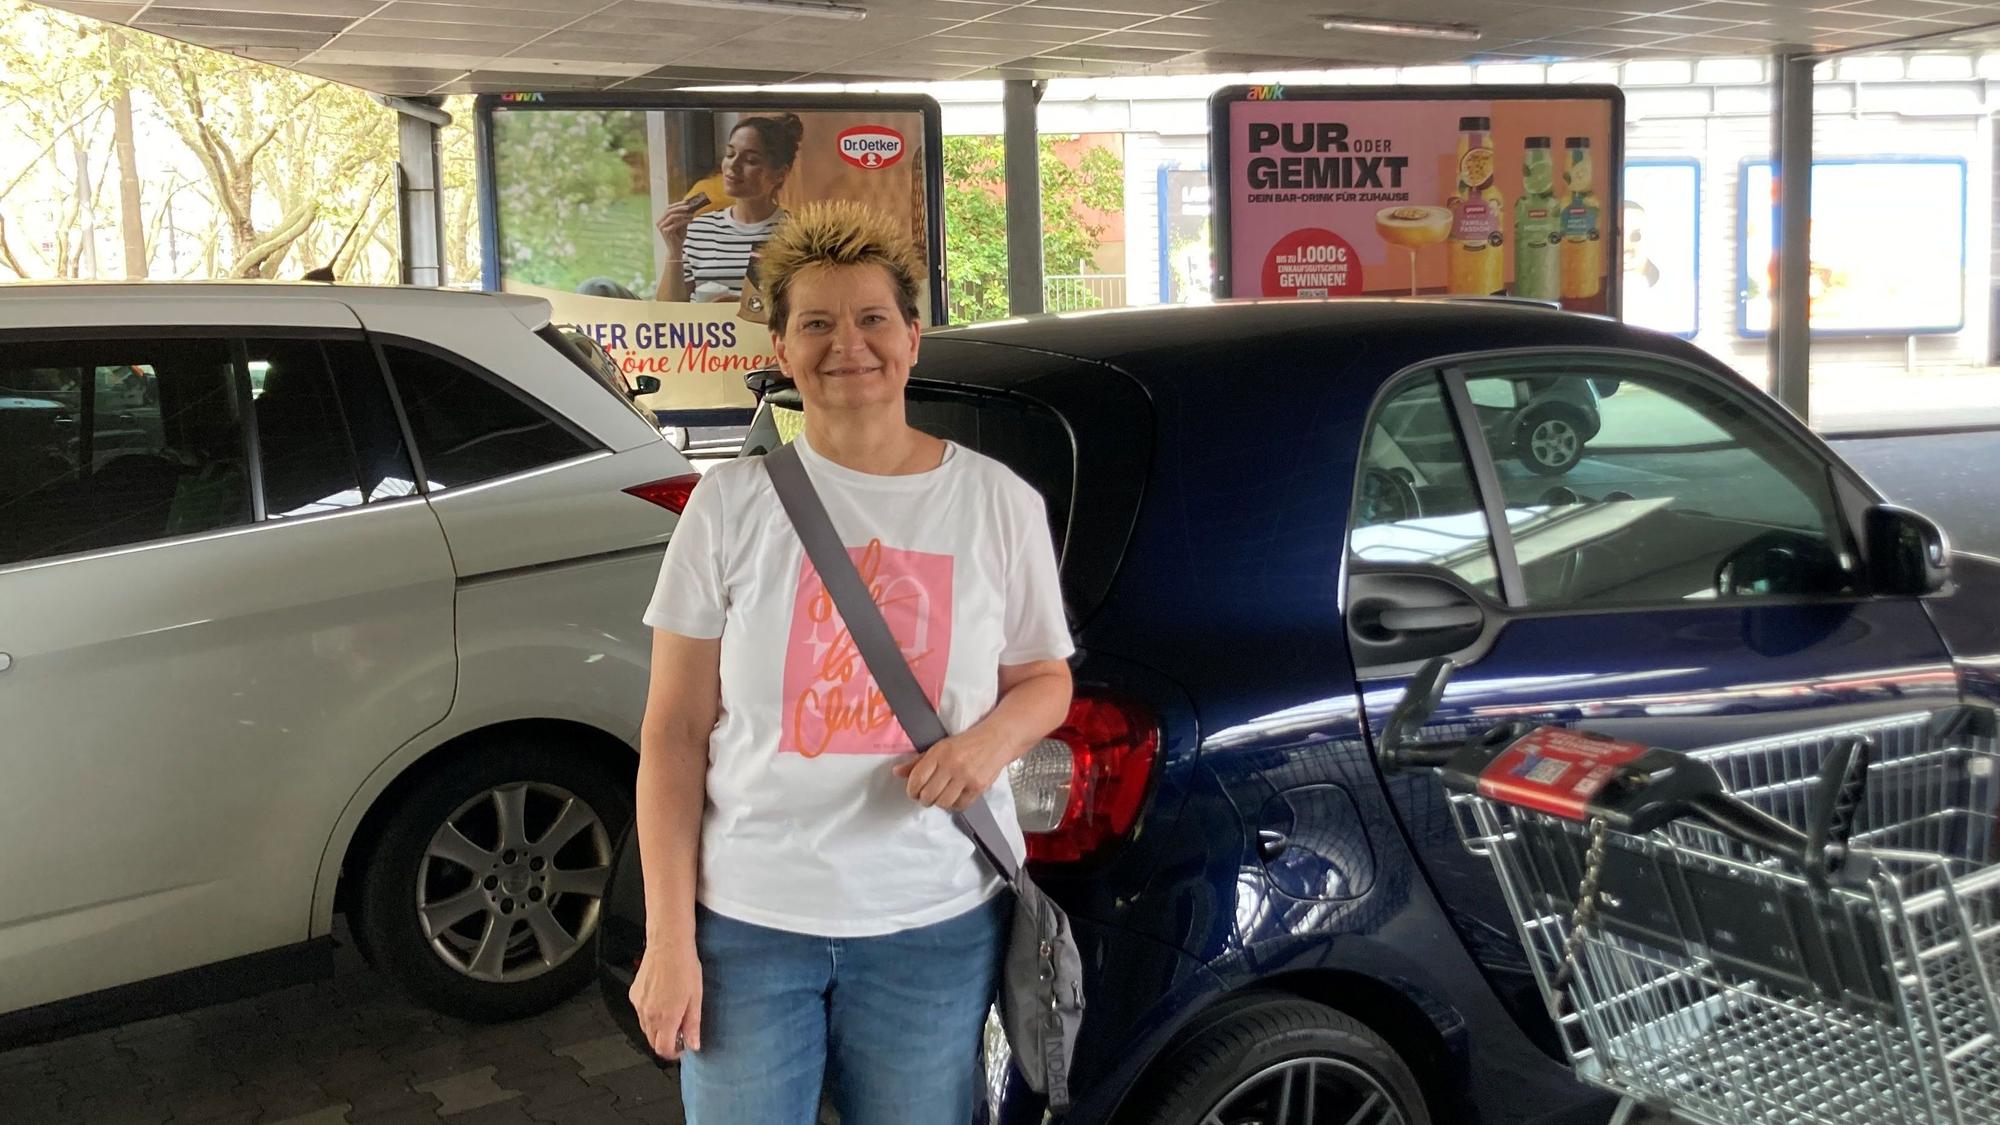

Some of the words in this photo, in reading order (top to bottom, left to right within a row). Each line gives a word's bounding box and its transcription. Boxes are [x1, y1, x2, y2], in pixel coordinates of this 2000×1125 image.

[1247, 81, 1284, 99] awk
[1248, 123, 1350, 153] PUR
[1353, 139, 1393, 152] ODER
[1247, 156, 1409, 190] GEMIXT
[1248, 193, 1273, 203] DEIN
[1275, 193, 1334, 203] BAR-DRINK
[1336, 192, 1357, 202] FÜR
[1358, 192, 1409, 202] ZUHAUSE
[1276, 255, 1287, 263] BIS
[1287, 255, 1297, 263] ZU
[1278, 264, 1348, 273] EINKAUFSGUTSCHEINE
[1280, 273, 1347, 287] GEWINNEN!
[635, 321, 737, 349] GENUSS
